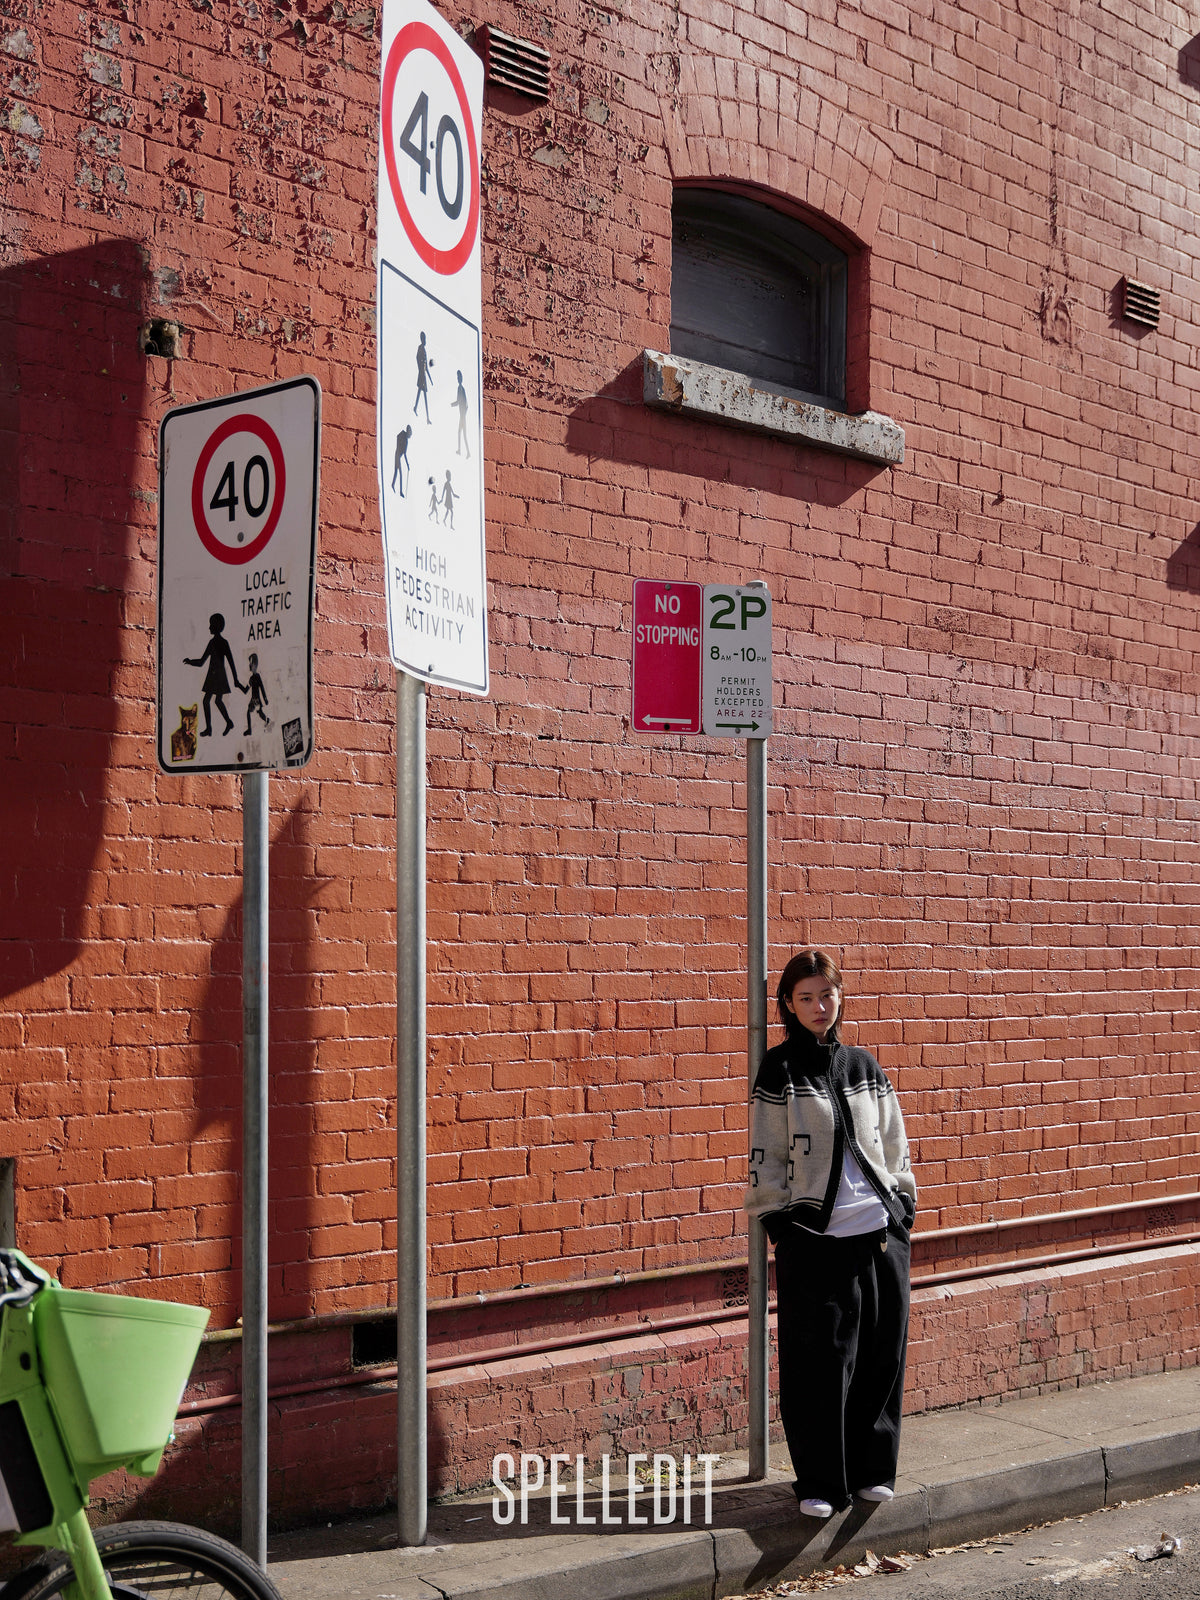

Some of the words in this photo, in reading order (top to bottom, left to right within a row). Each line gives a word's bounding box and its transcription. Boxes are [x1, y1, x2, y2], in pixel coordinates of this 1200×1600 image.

[400, 91, 463, 220] 40
[210, 455, 270, 522] 40
[416, 546, 447, 578] HIGH
[246, 567, 285, 591] LOCAL
[241, 591, 291, 617] TRAFFIC
[395, 567, 474, 618] PEDESTRIAN
[655, 594, 681, 614] NO
[405, 604, 464, 645] ACTIVITY
[709, 594, 767, 631] 2P
[247, 619, 281, 642] AREA
[636, 624, 699, 646] STOPPING
[717, 687, 761, 697] HOLDERS
[721, 676, 756, 686] PERMIT
[714, 697, 764, 707] EXCEPTED
[717, 708, 745, 717] AREA
